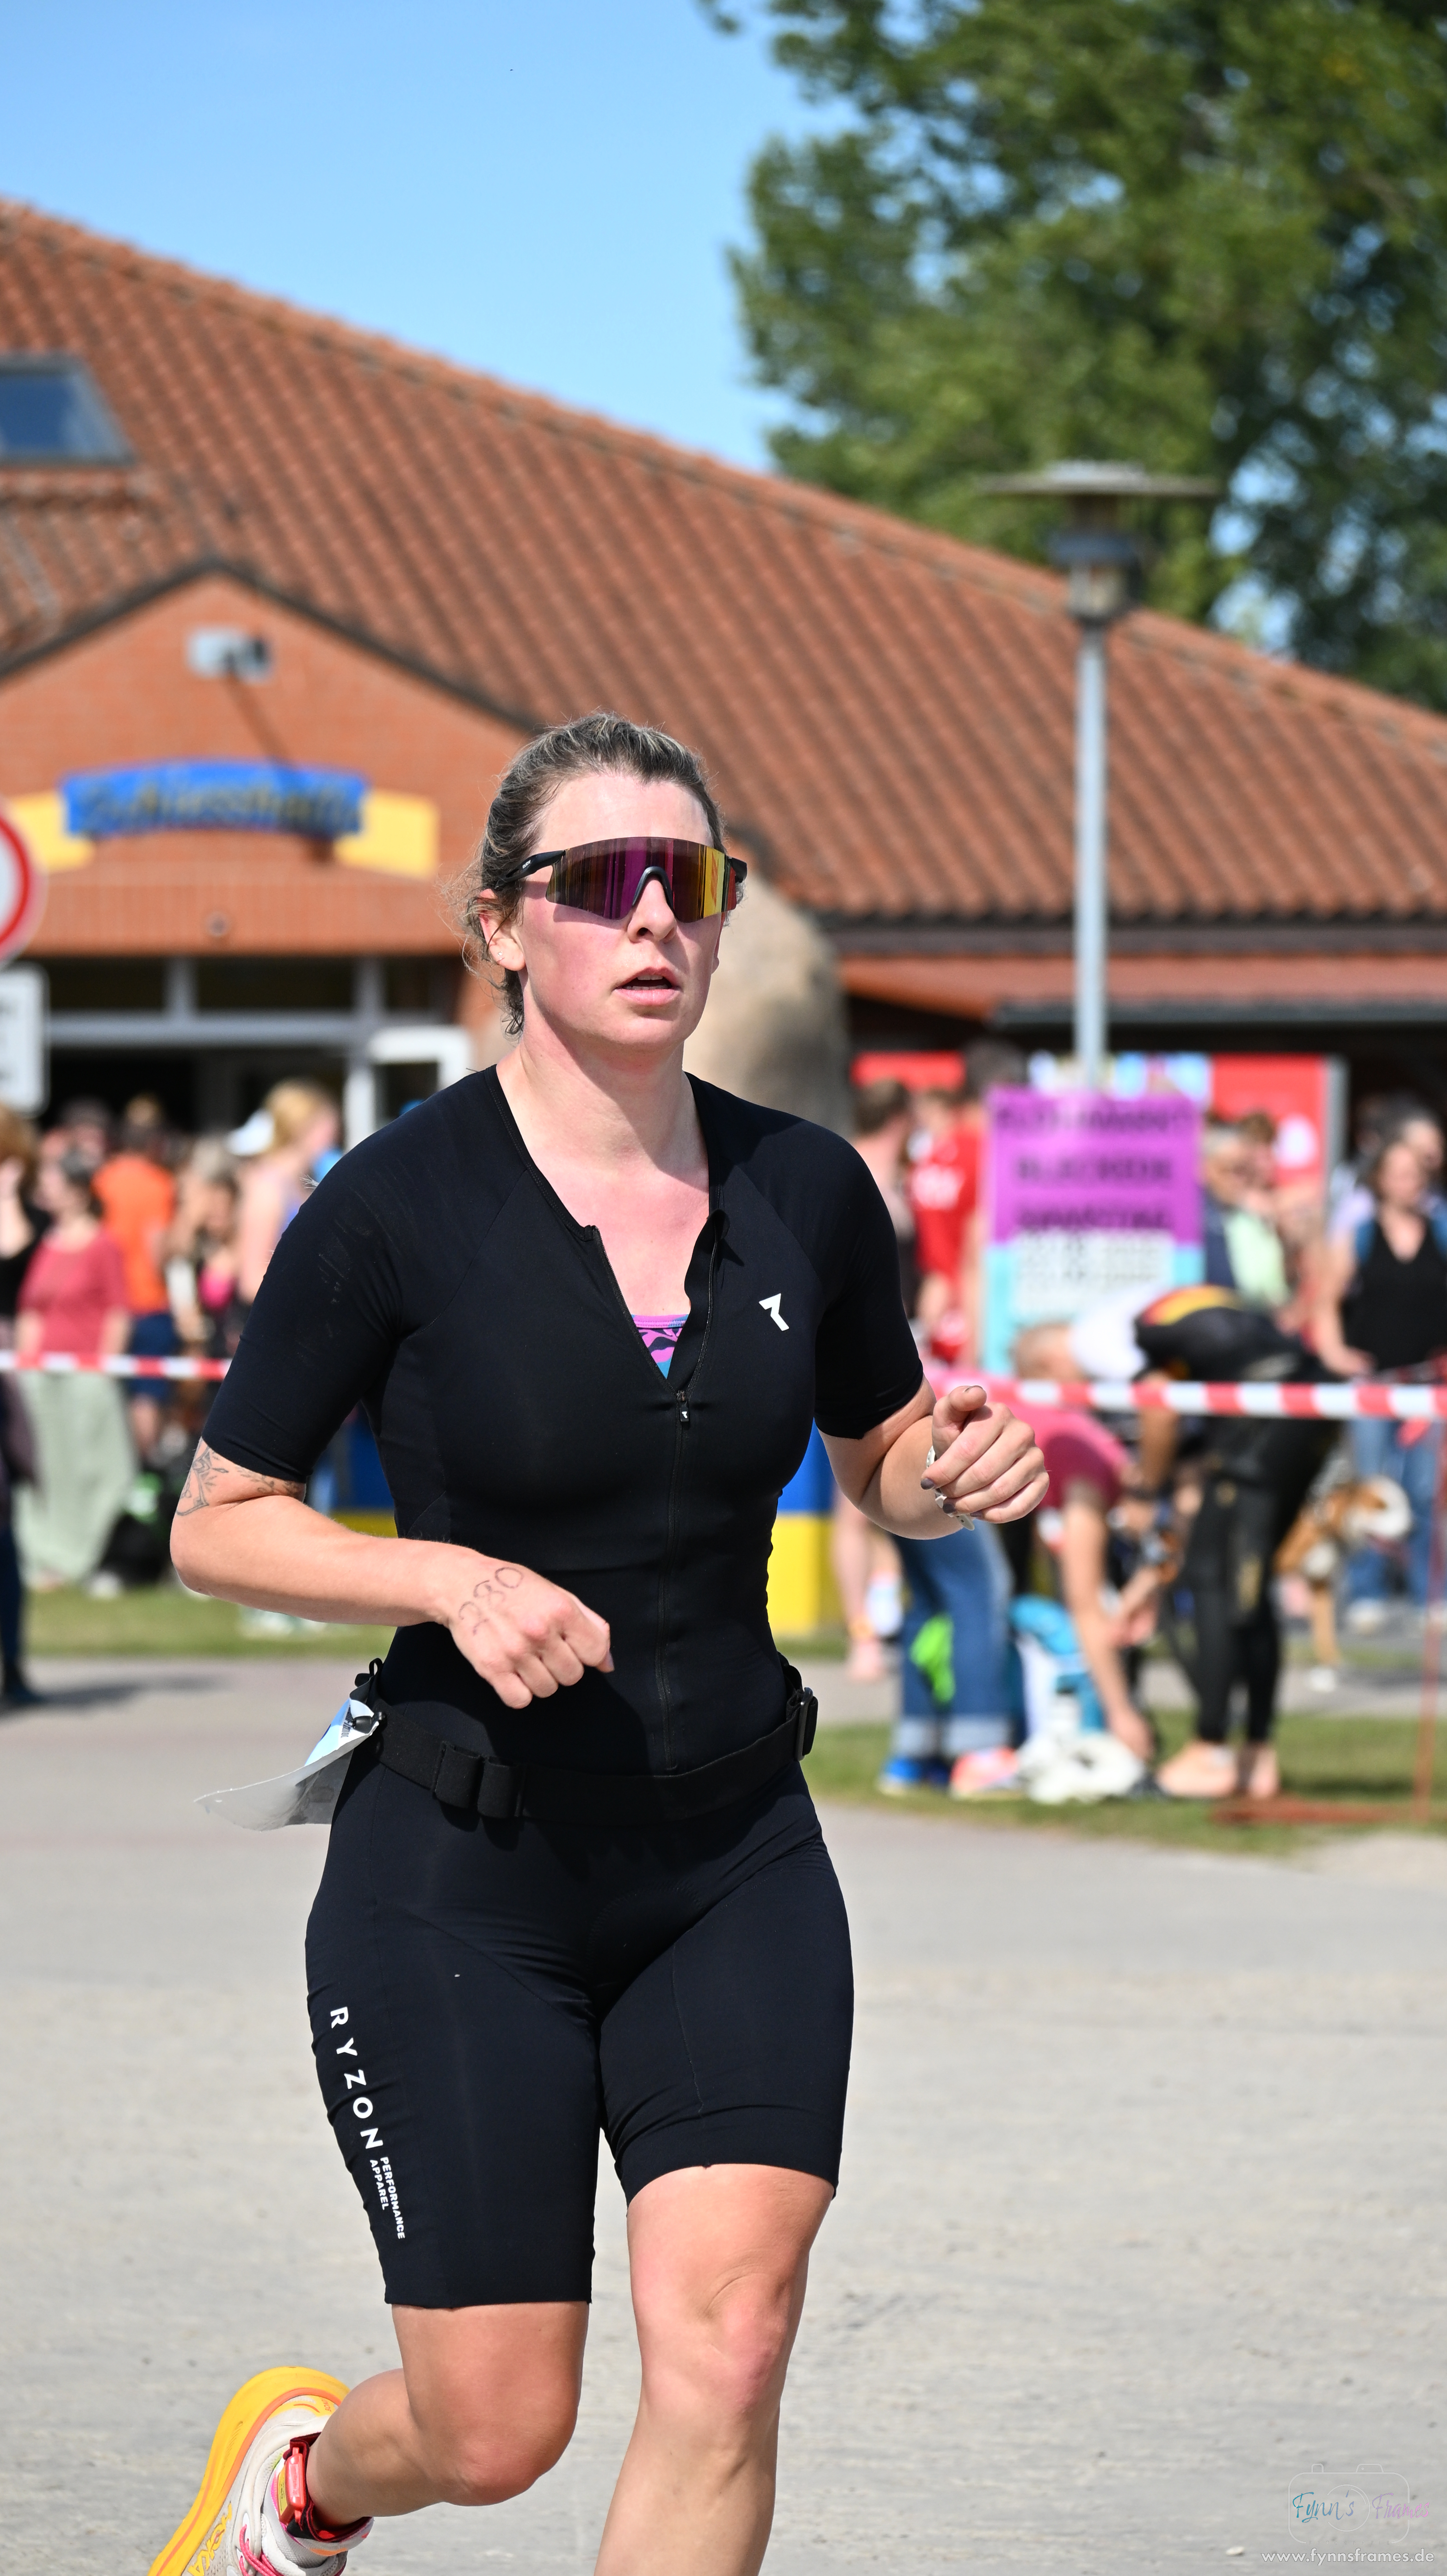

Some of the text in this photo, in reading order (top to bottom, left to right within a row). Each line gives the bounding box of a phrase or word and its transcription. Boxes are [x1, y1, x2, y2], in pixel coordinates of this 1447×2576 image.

[330, 2006, 383, 2149] RYZON
[370, 2160, 389, 2211] APPAREL
[380, 2156, 405, 2239] PERFORMANCE
[188, 2502, 233, 2576] HOKA
